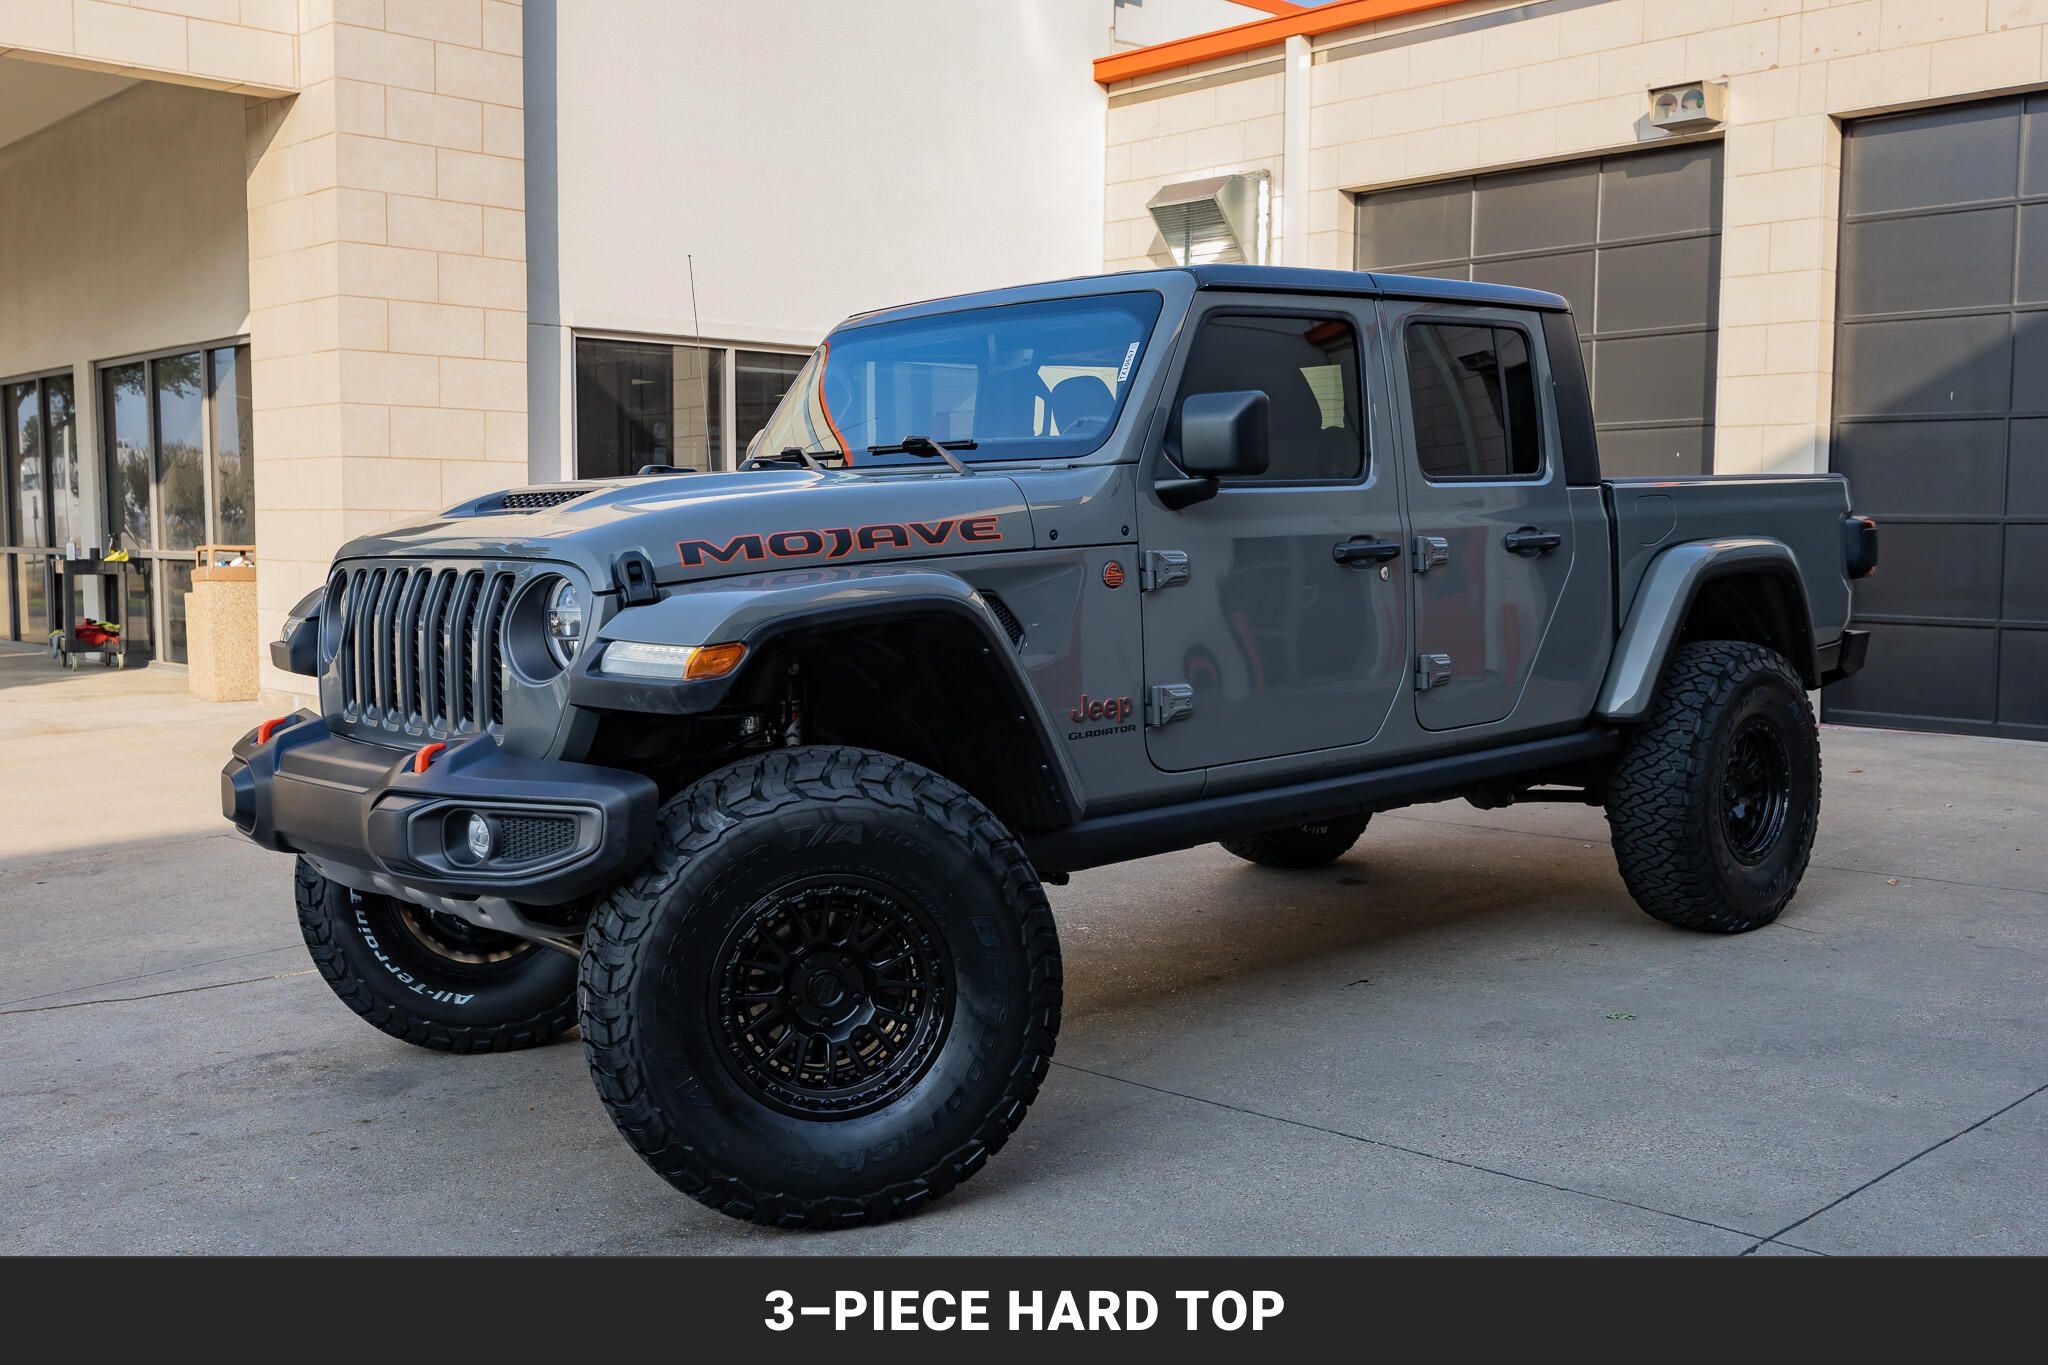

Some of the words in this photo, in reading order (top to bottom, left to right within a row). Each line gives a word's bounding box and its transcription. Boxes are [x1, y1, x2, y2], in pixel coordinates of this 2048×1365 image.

[676, 516, 1003, 567] MOJAVE
[1070, 694, 1133, 724] Jeep
[1068, 724, 1137, 741] GLADIATOR
[354, 909, 475, 1006] All-Terrain
